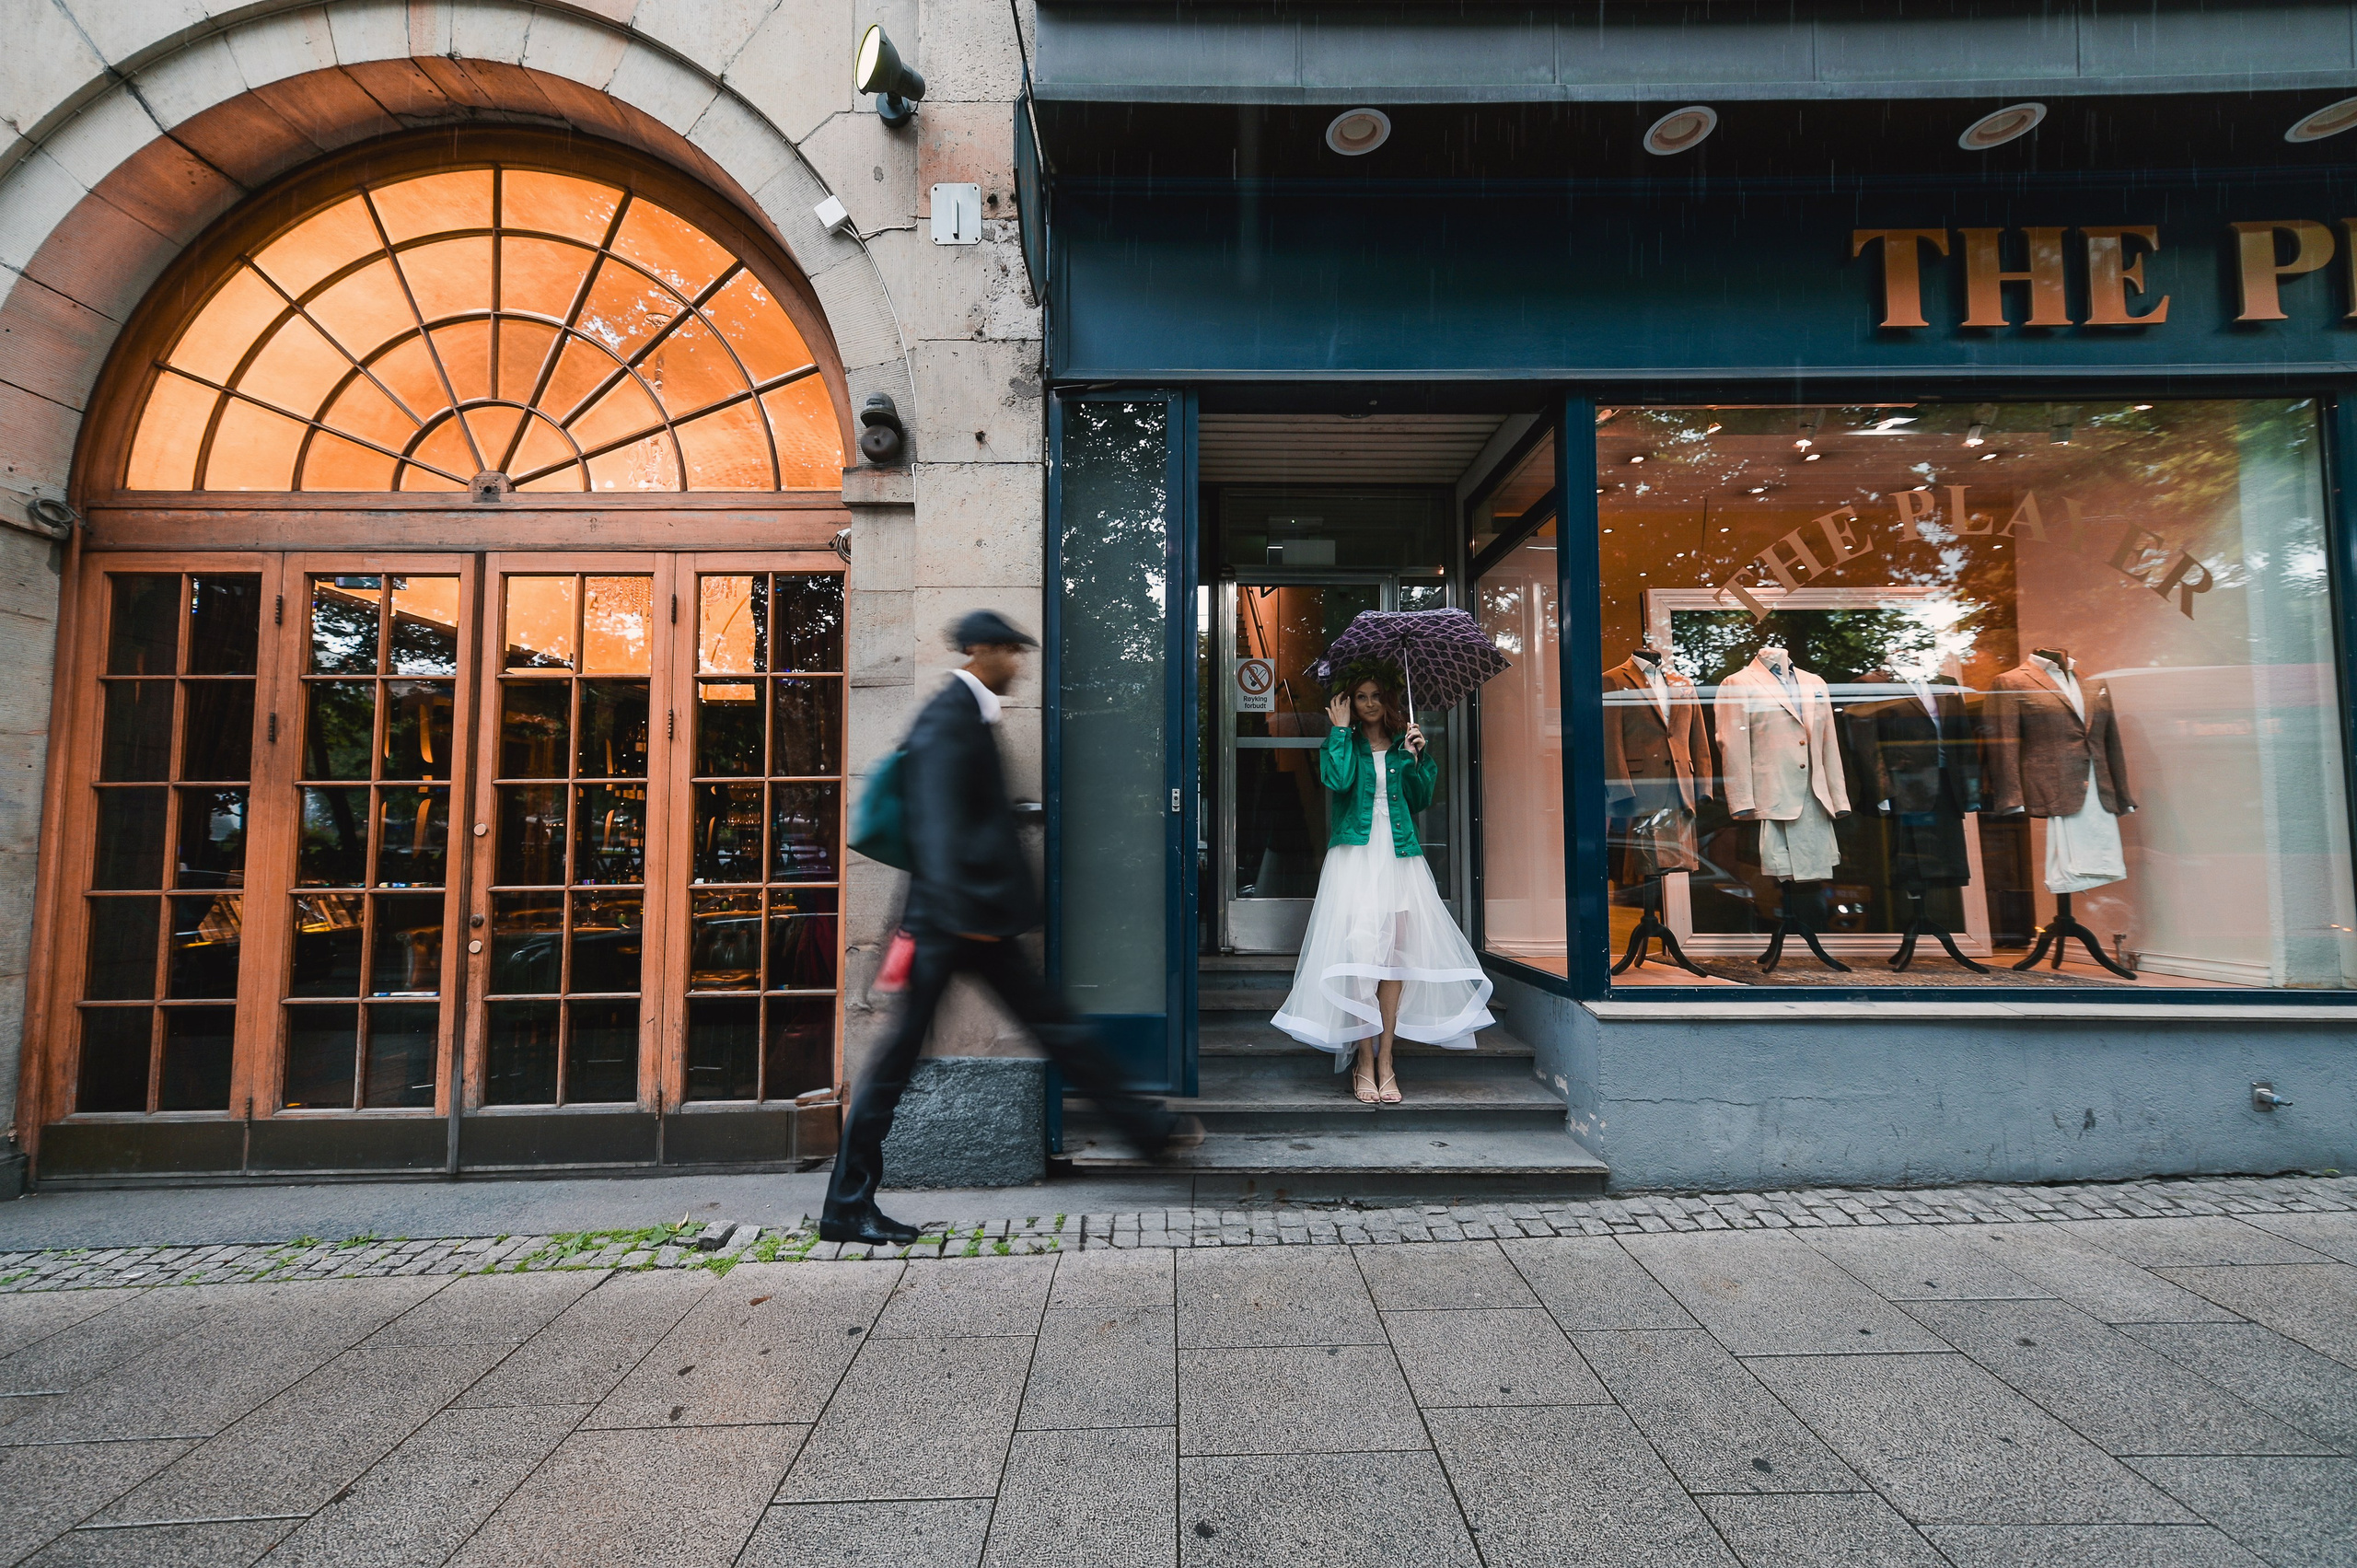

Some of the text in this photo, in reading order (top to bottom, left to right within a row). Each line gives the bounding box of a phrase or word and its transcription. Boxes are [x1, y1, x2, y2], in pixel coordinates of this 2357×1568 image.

[1852, 216, 2357, 328] THE P
[1713, 505, 1874, 626] THE
